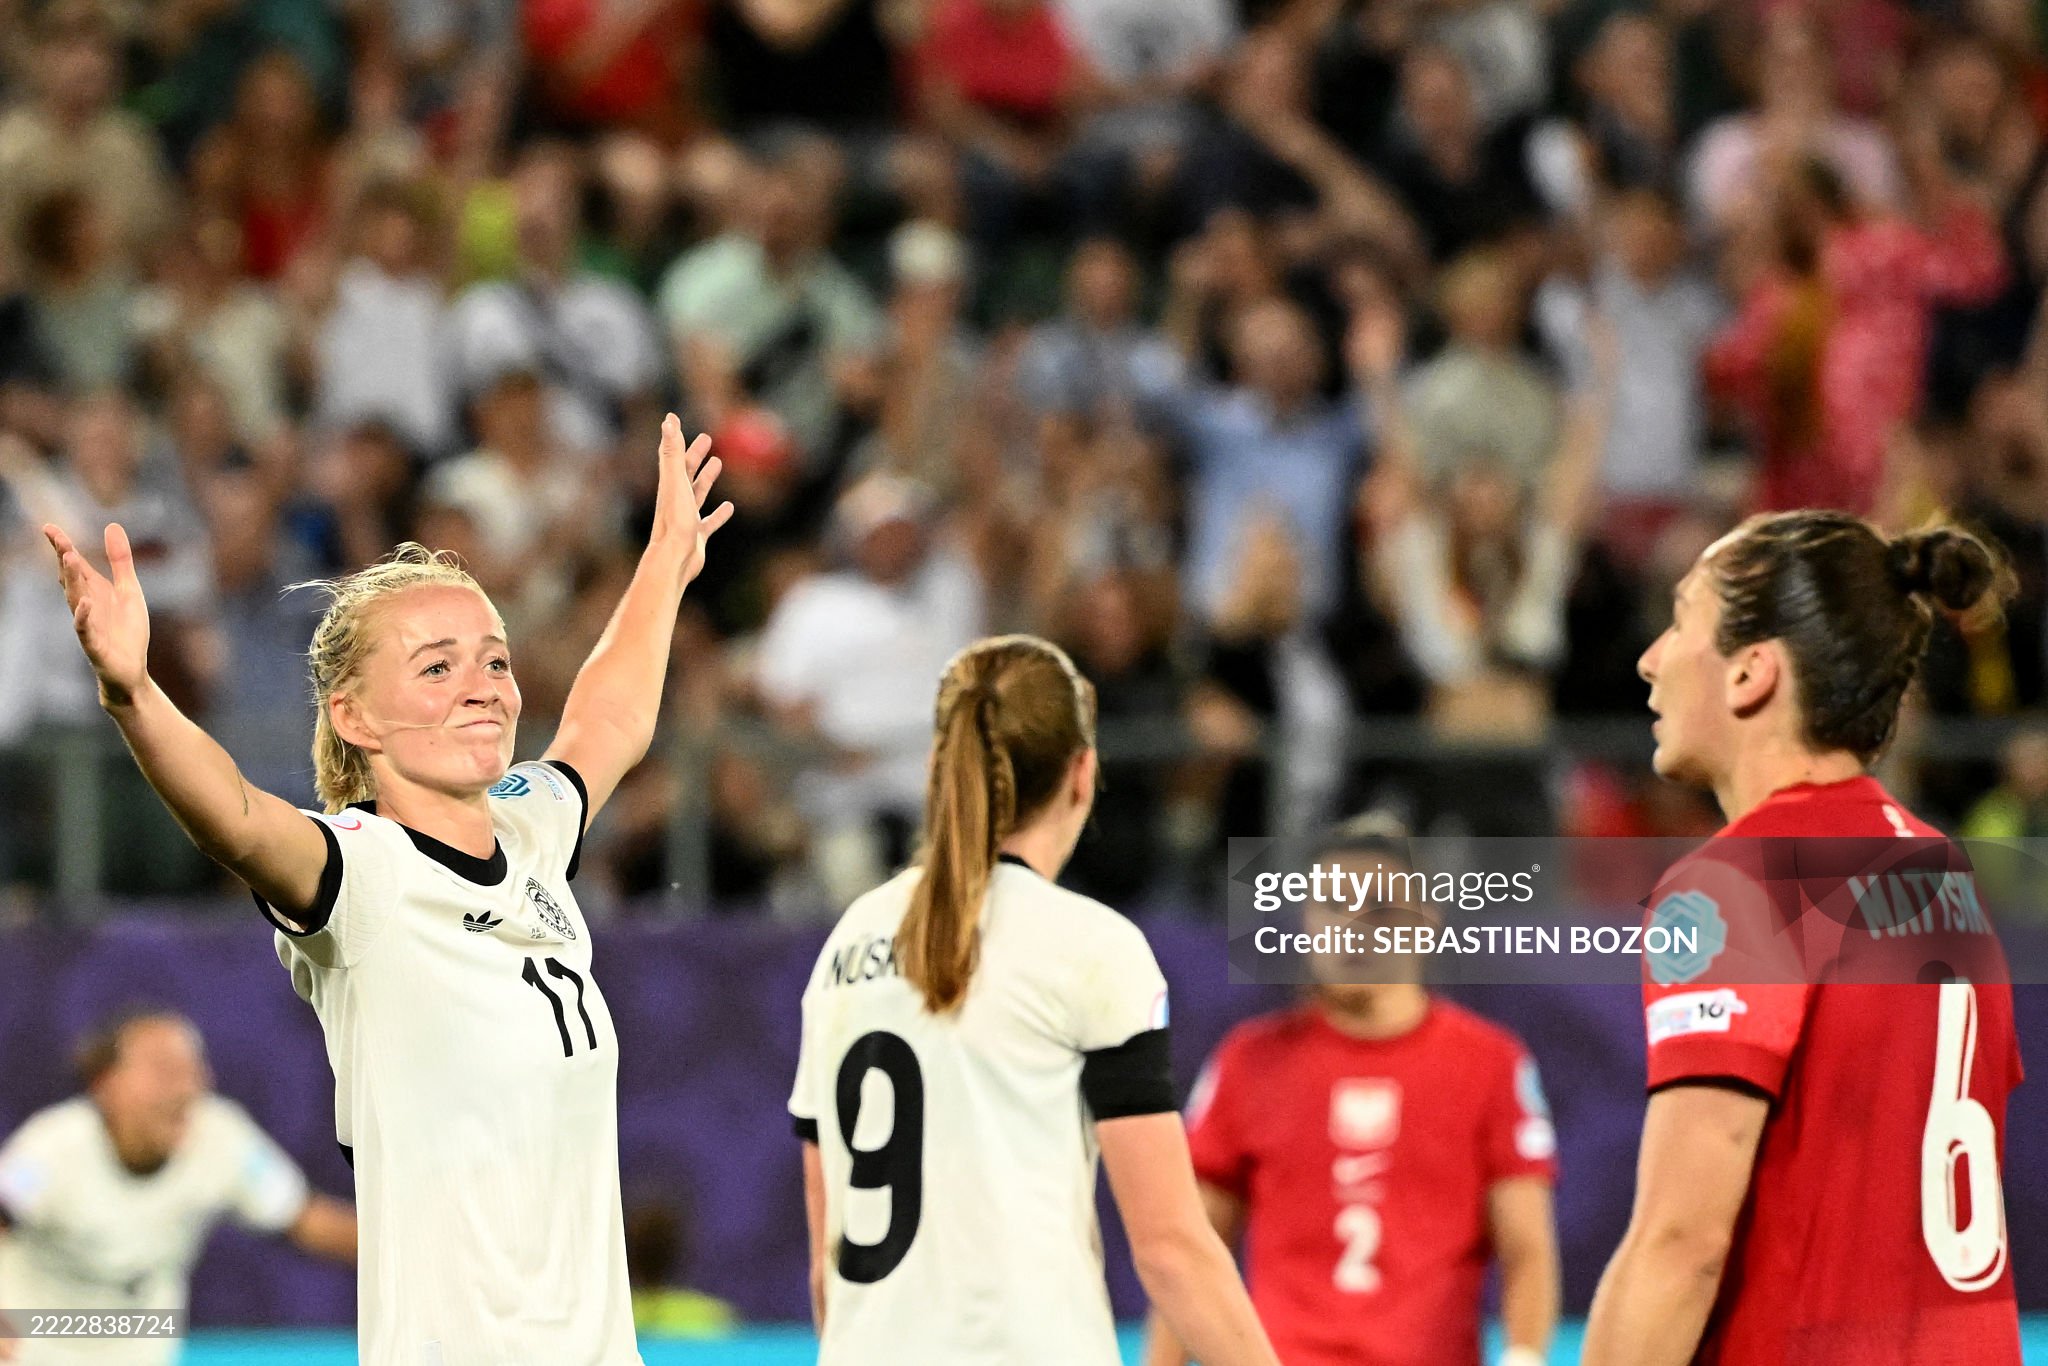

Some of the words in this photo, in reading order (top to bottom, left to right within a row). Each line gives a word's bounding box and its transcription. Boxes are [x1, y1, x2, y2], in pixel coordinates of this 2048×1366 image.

[836, 1031, 924, 1285] 9
[1332, 1203, 1383, 1294] 2
[1921, 976, 2008, 1293] 6
